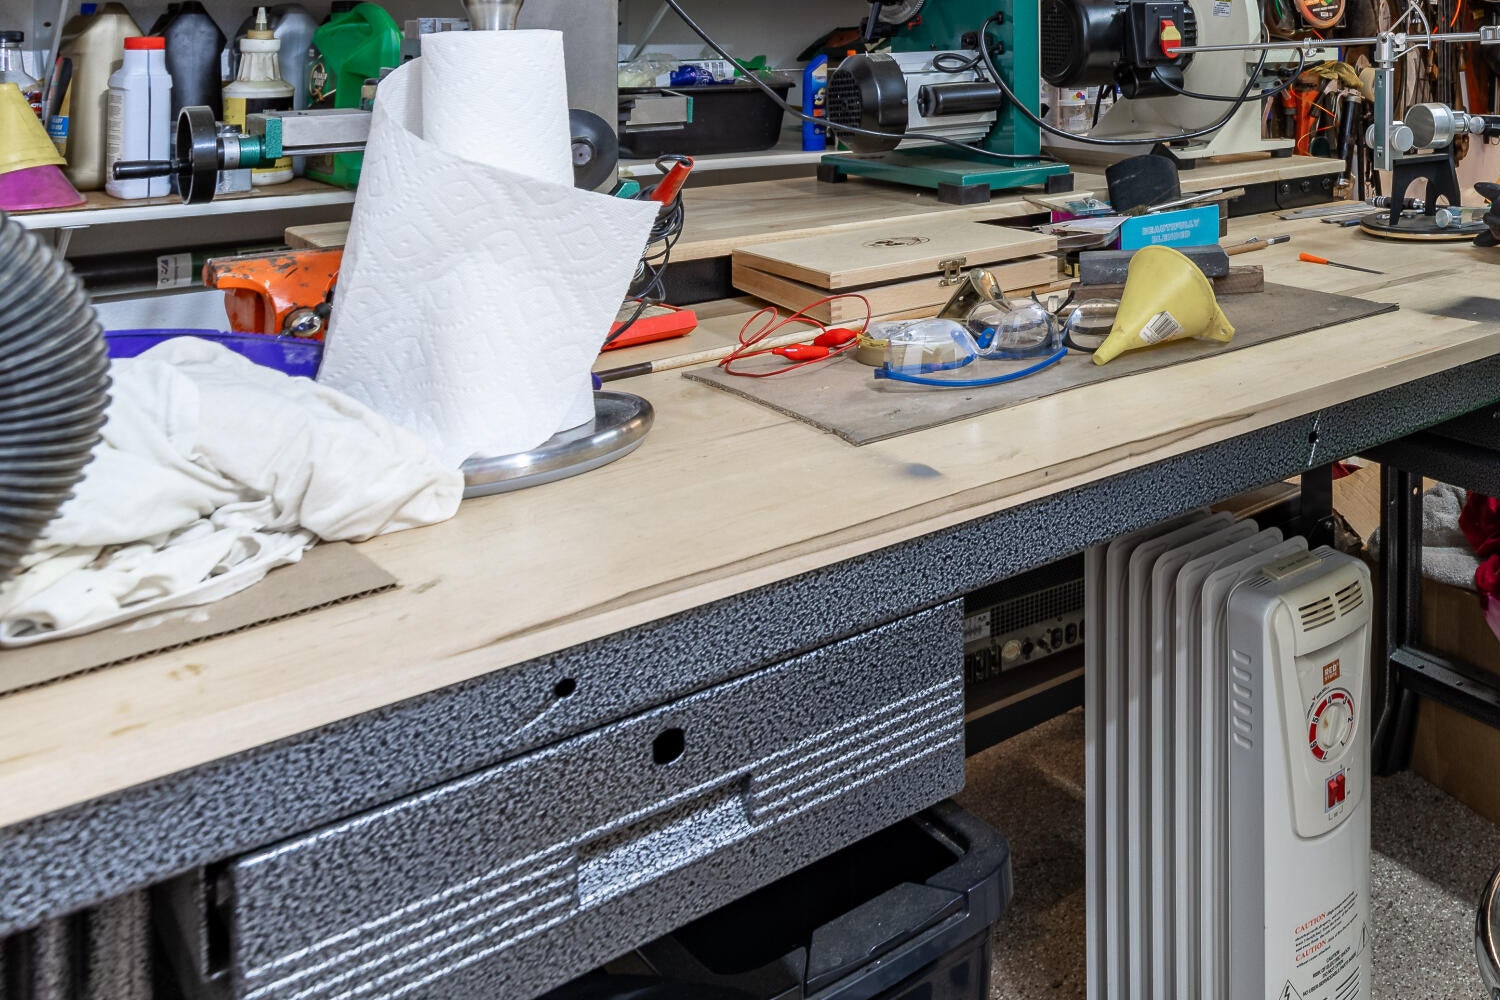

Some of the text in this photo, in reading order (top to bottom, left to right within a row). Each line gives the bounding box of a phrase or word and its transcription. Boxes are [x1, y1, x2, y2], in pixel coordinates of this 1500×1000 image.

[1324, 664, 1337, 675] RED
[1295, 912, 1326, 934] CAUTION
[1296, 940, 1326, 961] CAUTION
